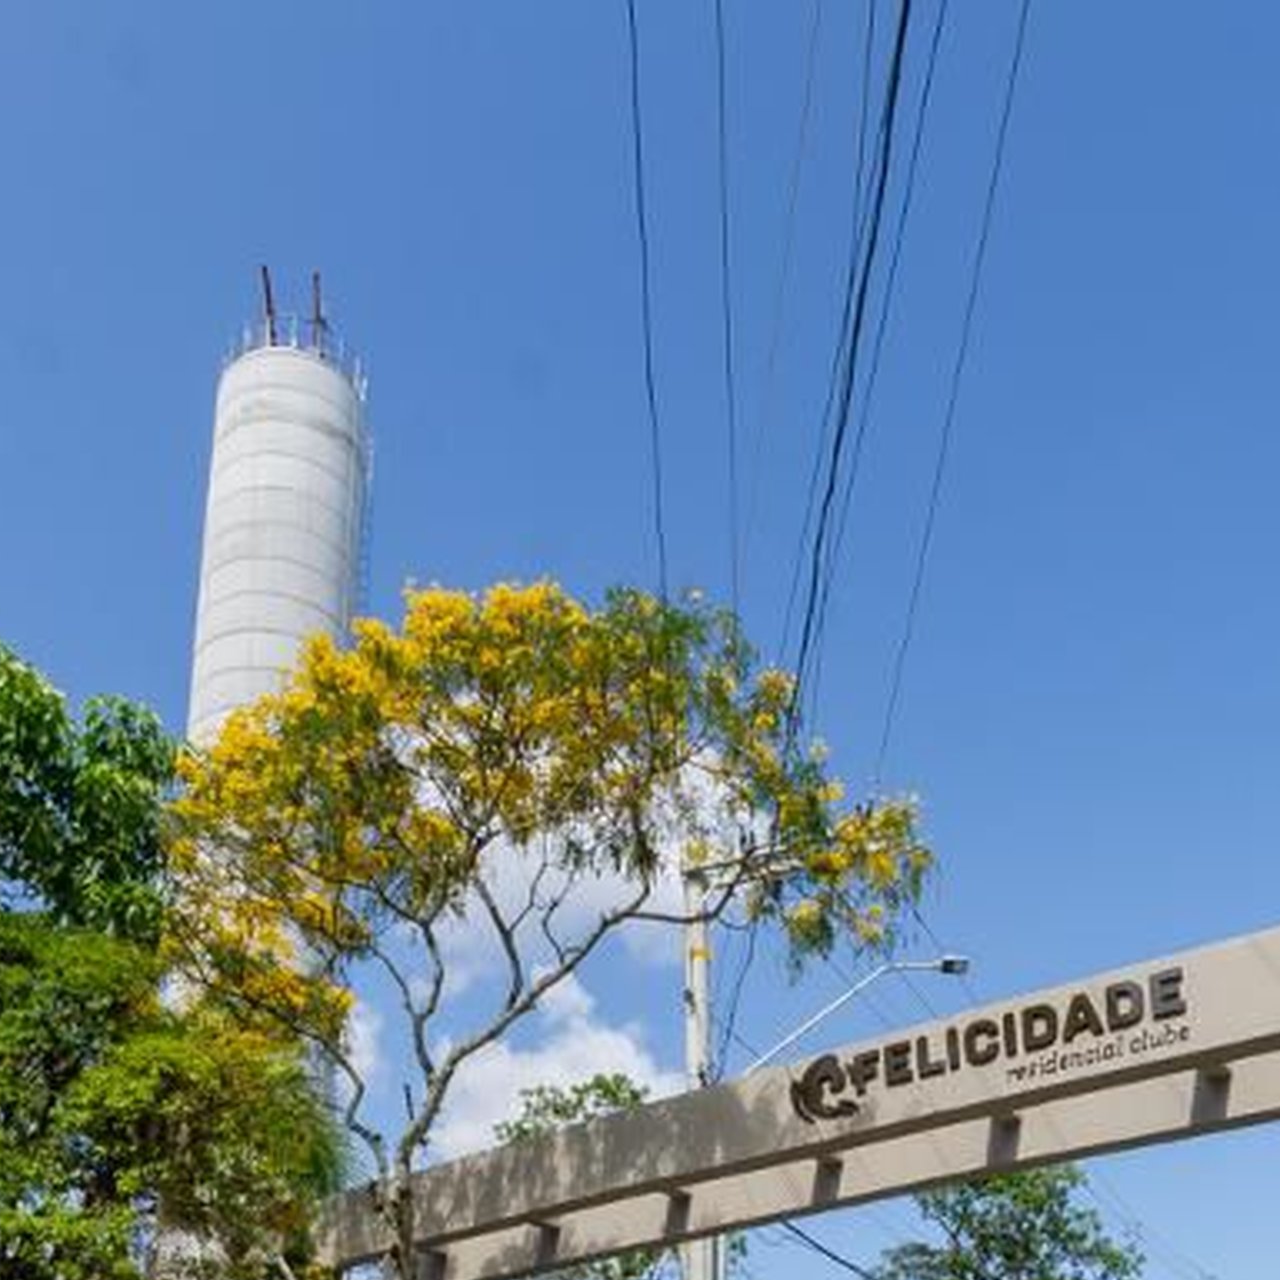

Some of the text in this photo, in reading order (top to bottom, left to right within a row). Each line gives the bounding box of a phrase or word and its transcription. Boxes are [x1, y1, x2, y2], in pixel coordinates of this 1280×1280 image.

[847, 967, 1186, 1097] FELICIDADE
[1006, 1022, 1190, 1082] residencial clube
